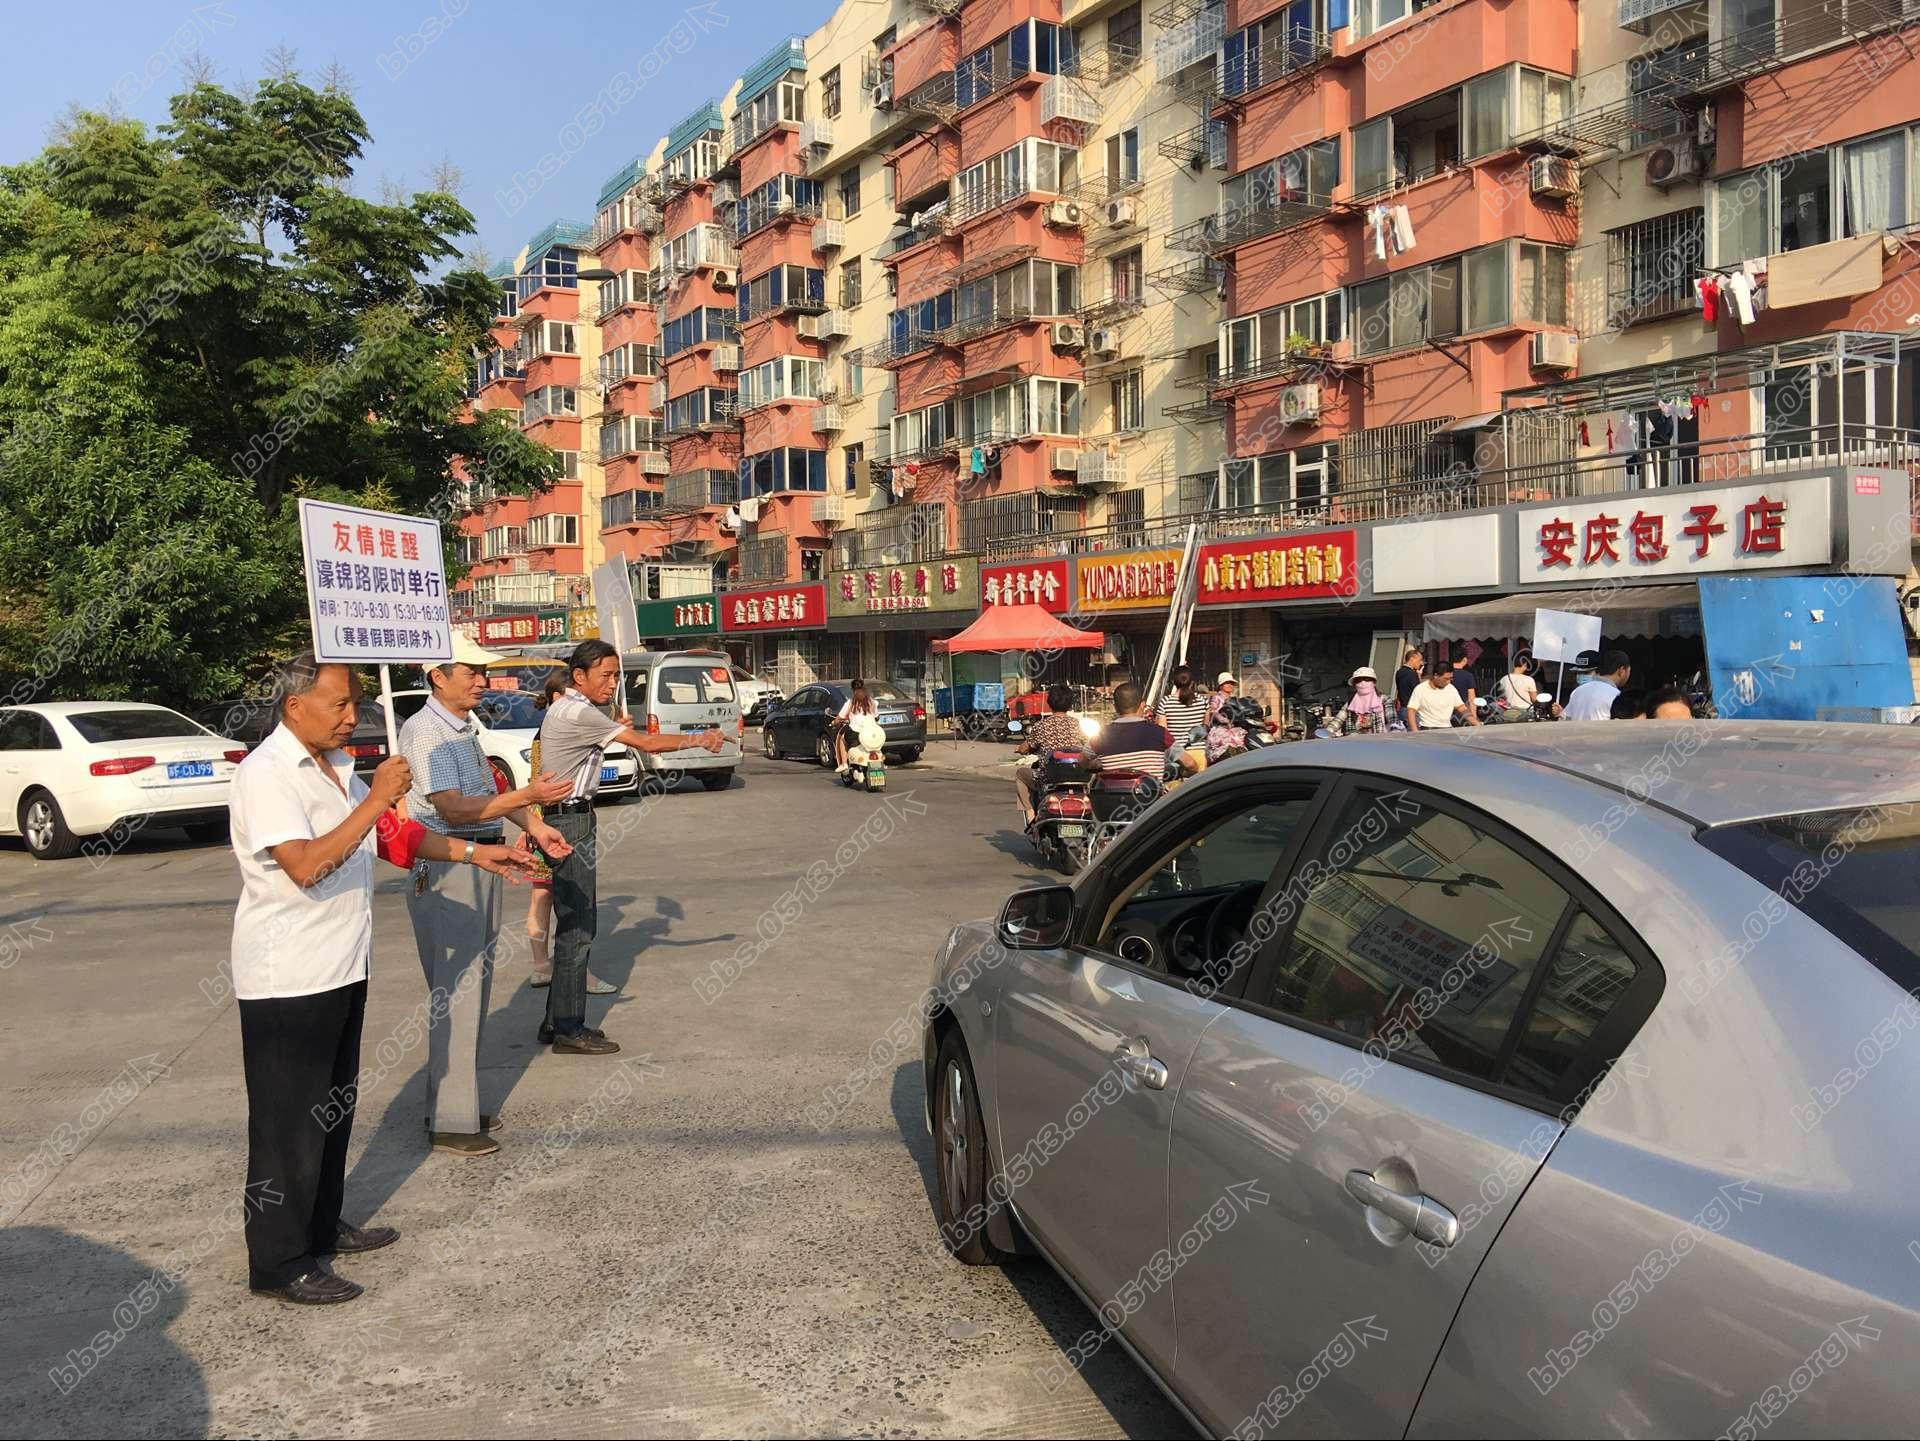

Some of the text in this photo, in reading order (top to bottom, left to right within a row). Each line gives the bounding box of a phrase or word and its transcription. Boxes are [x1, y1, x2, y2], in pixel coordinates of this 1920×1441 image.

[332, 521, 420, 561] 友情提醒
[1539, 495, 1787, 567] 安庆包子店
[316, 559, 440, 597] 濠锦路限时单行
[1203, 544, 1343, 592] 小黄不锈钢装饰部
